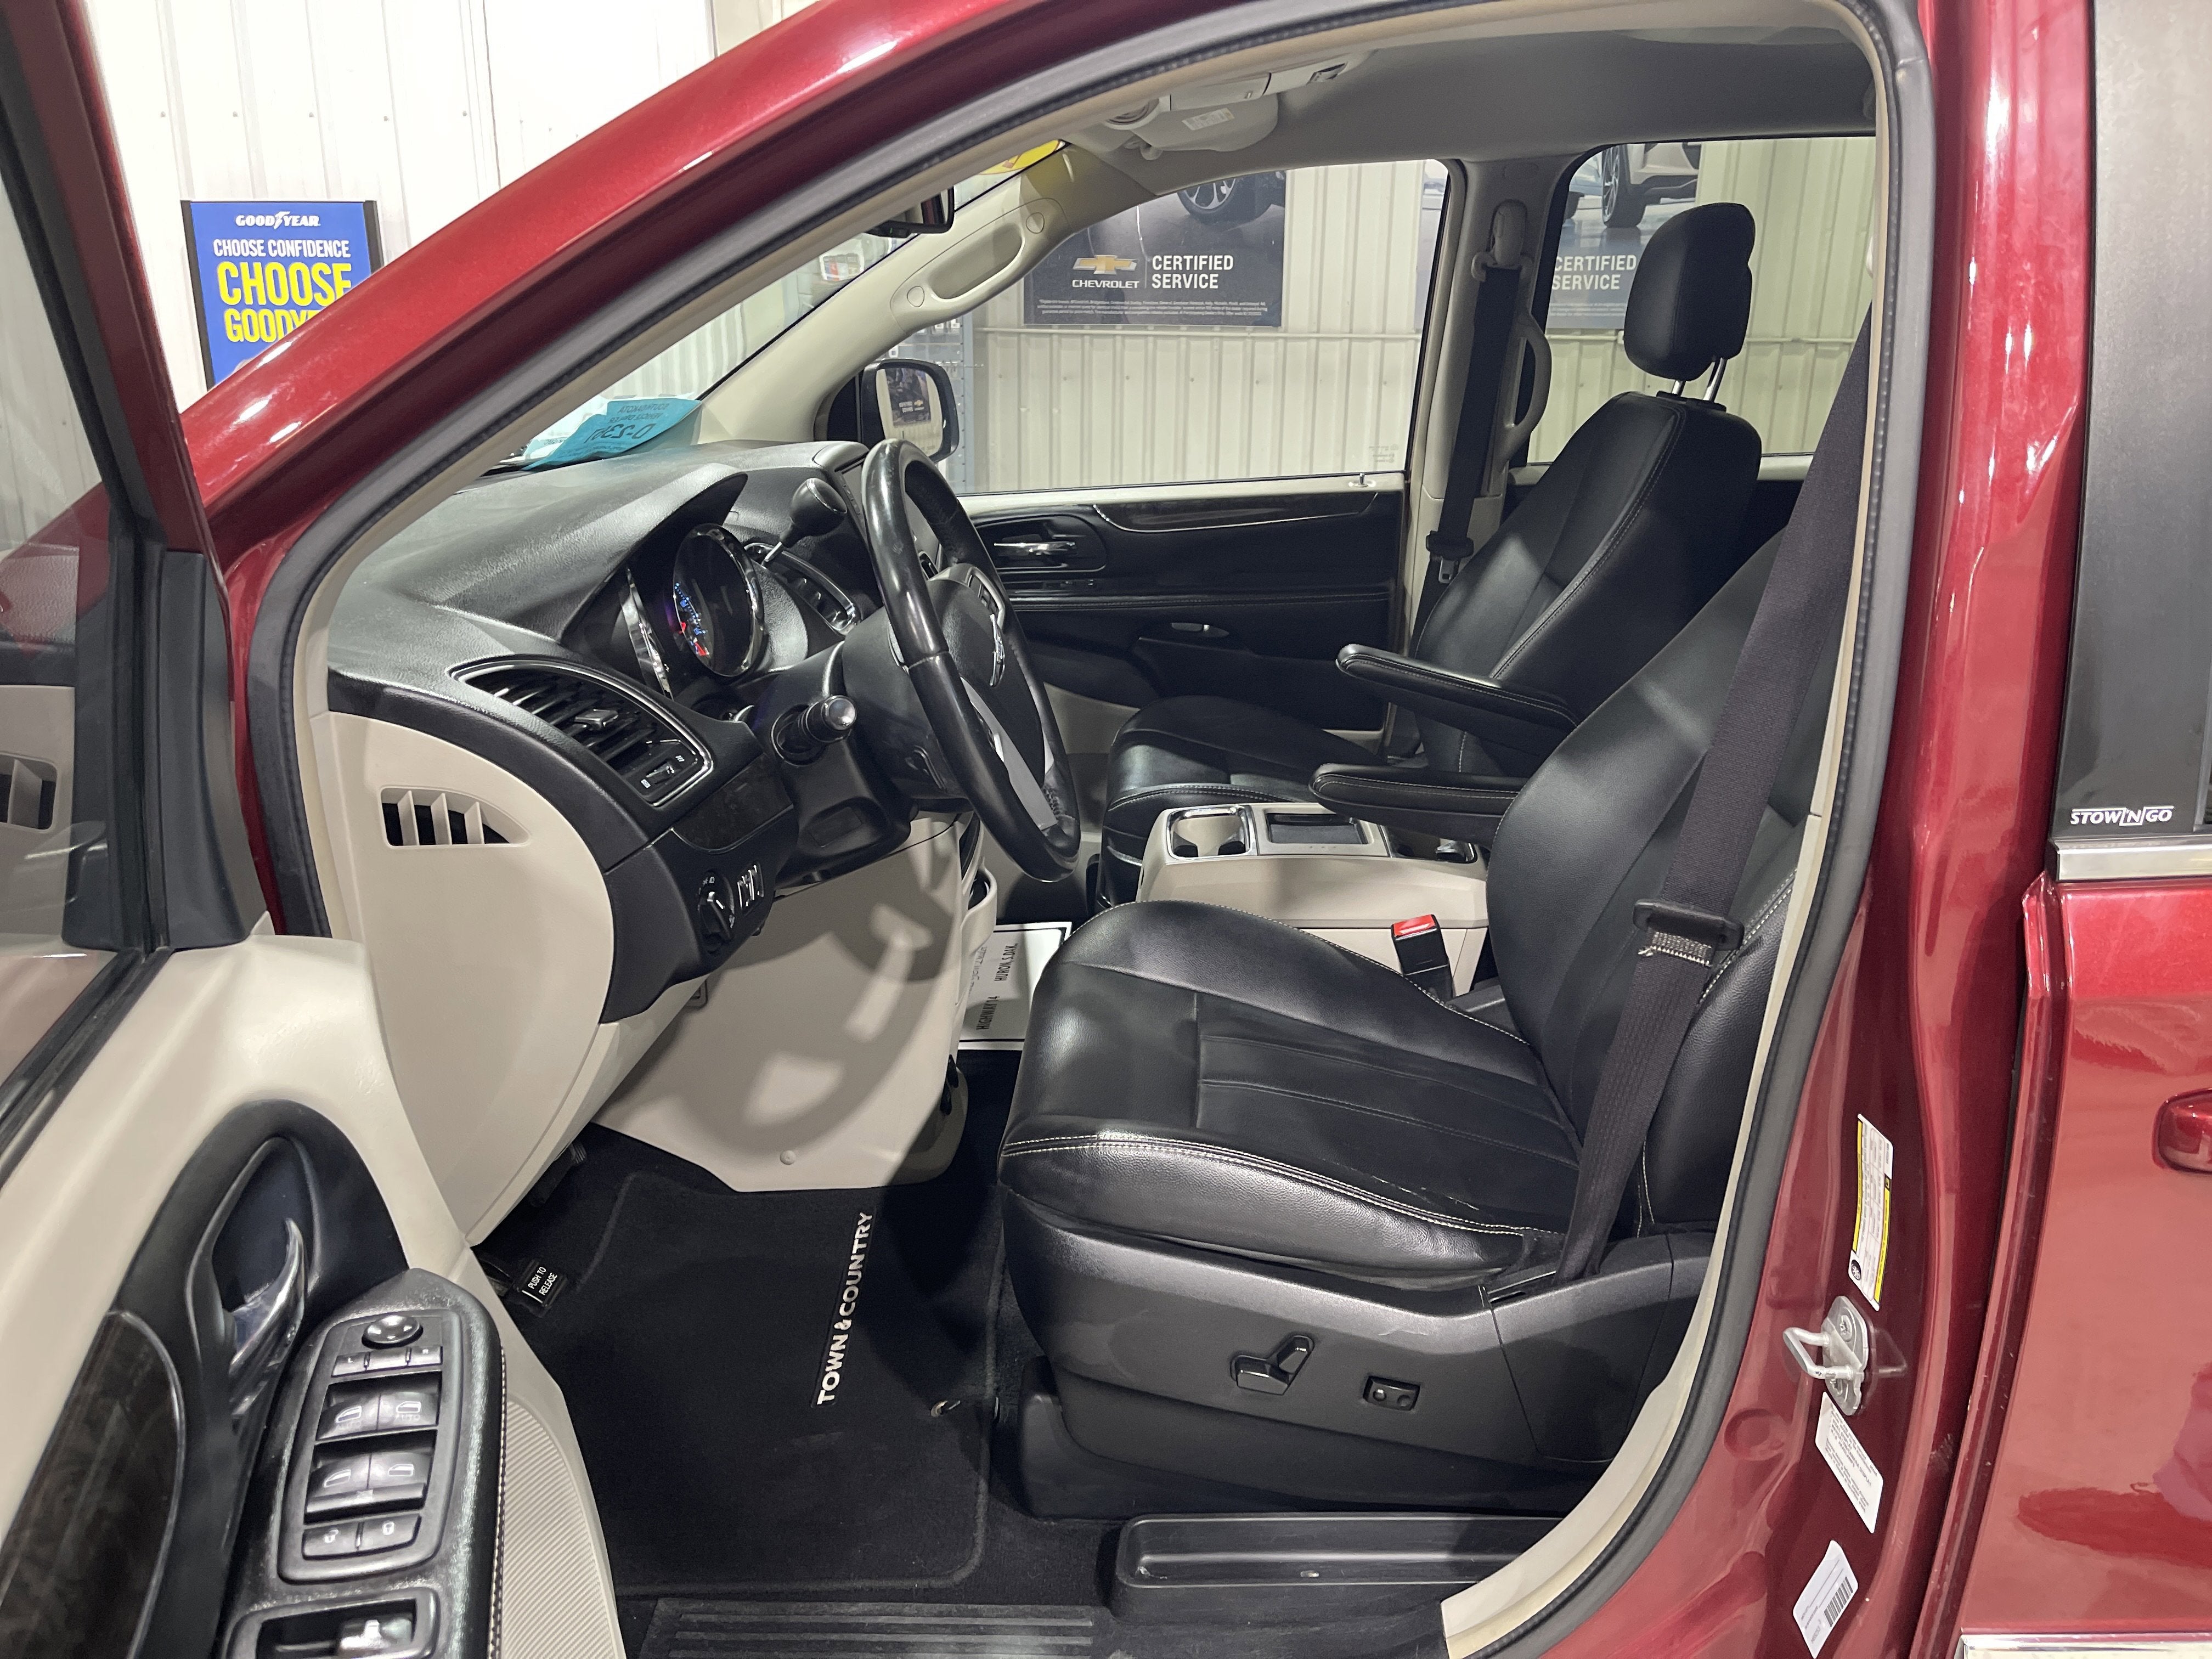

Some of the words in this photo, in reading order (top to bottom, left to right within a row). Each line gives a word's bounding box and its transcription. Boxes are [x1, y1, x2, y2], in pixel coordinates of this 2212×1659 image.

[235, 211, 320, 229] GOODYEAR
[213, 239, 266, 257] CHOOSE
[267, 239, 352, 258] CONFIDENCE
[1152, 255, 1234, 271] CERTIFIED
[1554, 255, 1637, 272] CERTIFIED
[217, 261, 352, 307] CHOOSE
[1072, 279, 1139, 289] CHEVROLET
[1152, 273, 1218, 289] SERVICE
[1551, 274, 1621, 290] SERVICE
[224, 308, 324, 343] GOODY
[839, 1212, 873, 1317] COUNTRY
[527, 1274, 542, 1289] PUSH
[537, 1266, 546, 1275] TO
[538, 1272, 558, 1296] RELEASE
[834, 1319, 852, 1331] &
[817, 1334, 849, 1405] TOWN
